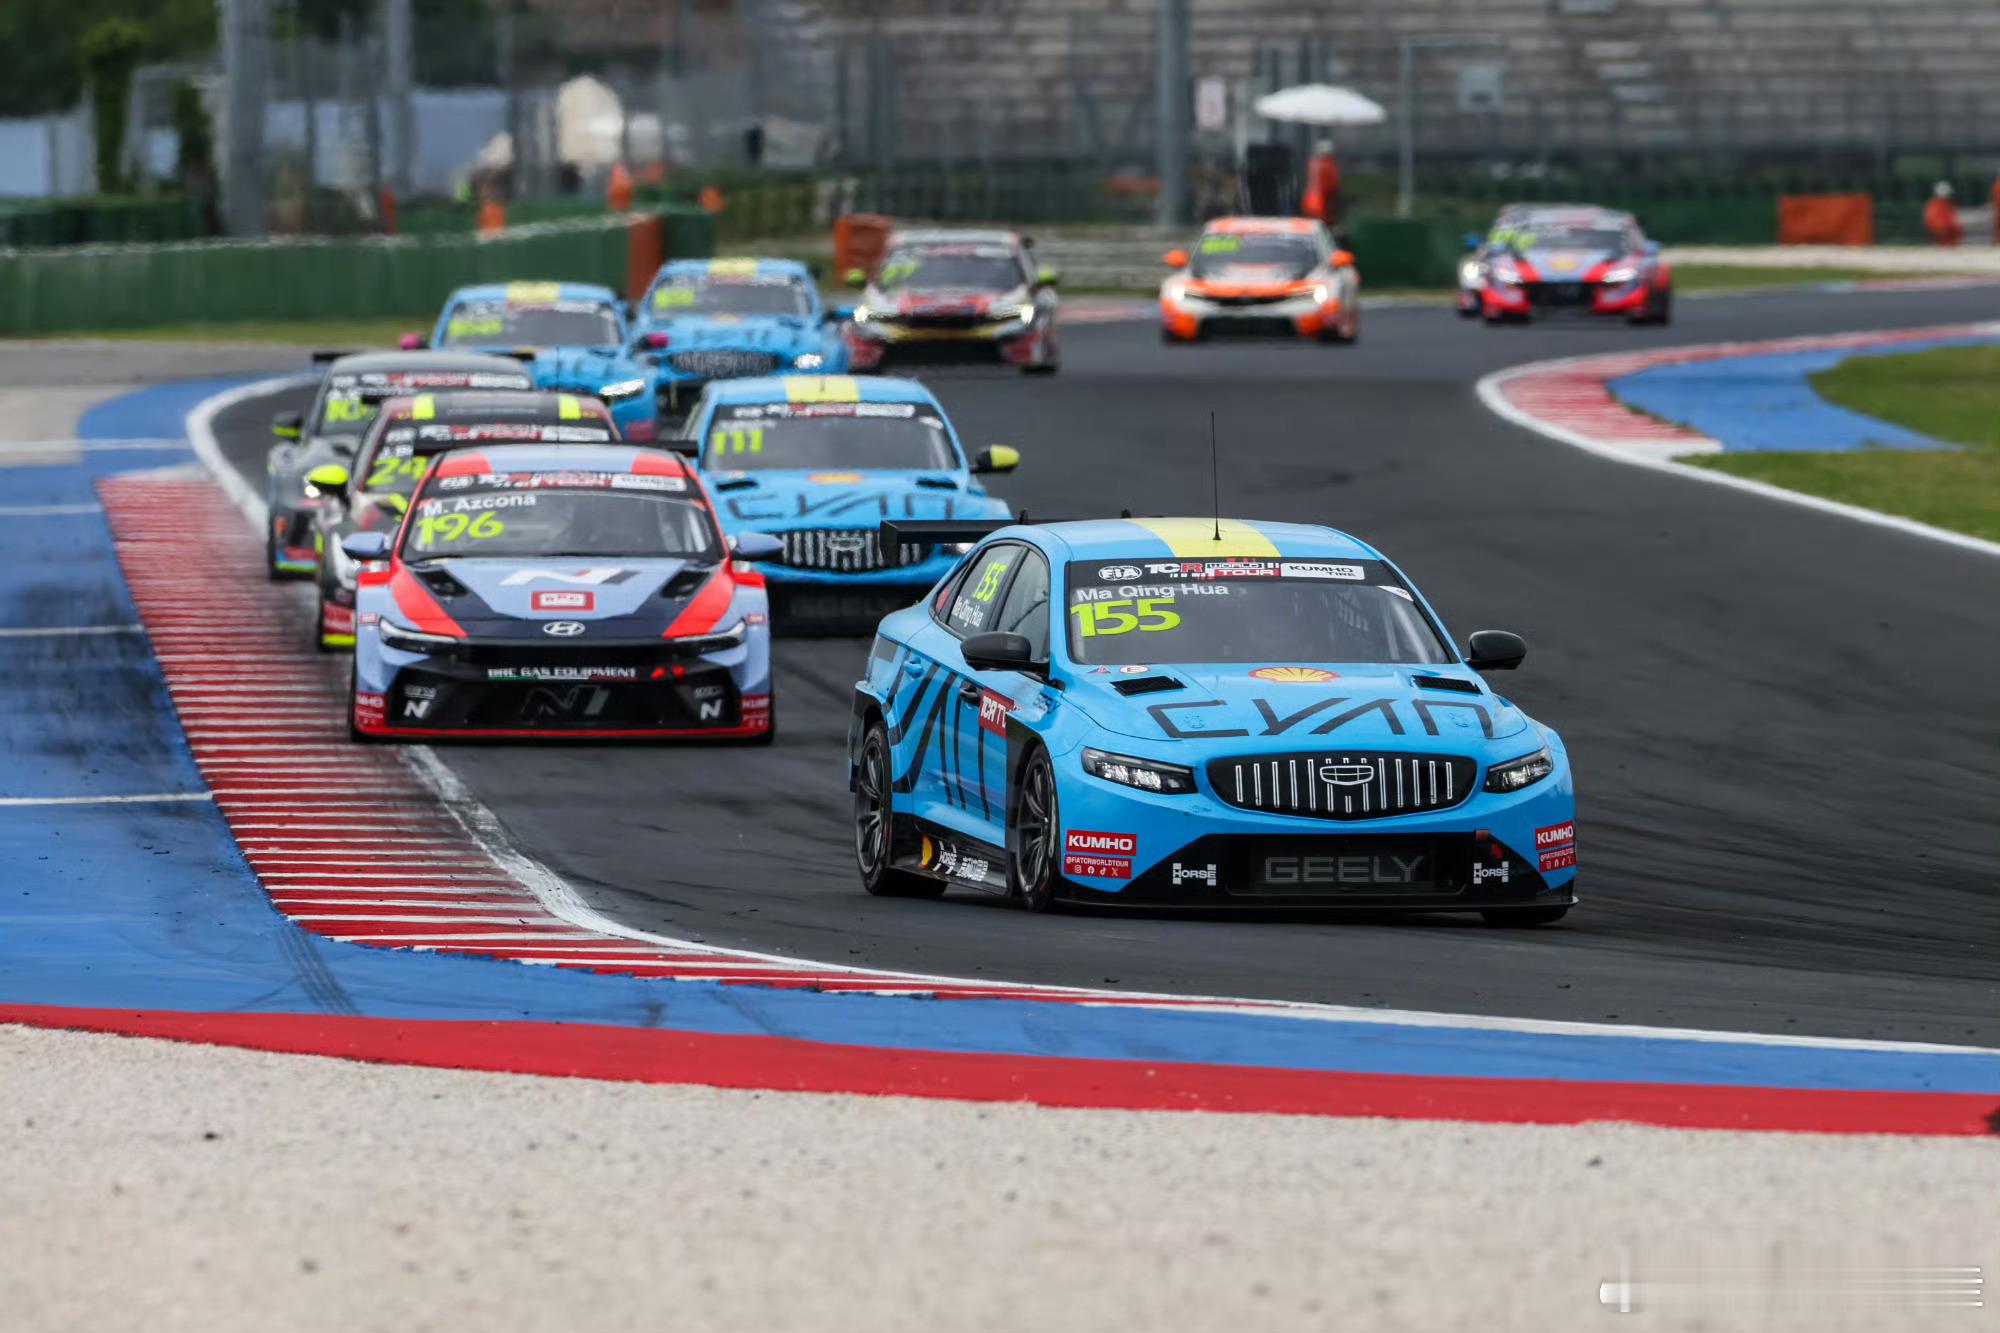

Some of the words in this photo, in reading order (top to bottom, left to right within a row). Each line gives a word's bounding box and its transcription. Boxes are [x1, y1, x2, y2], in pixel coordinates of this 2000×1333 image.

[713, 429, 764, 455] 111
[367, 456, 428, 486] 24
[424, 501, 449, 517] M.
[454, 494, 537, 512] Azcona
[416, 511, 505, 545] 196
[1100, 566, 1142, 580] FIA
[1145, 563, 1202, 574] TCR
[1219, 569, 1275, 577] TOUR
[1289, 565, 1354, 573] KUMHO
[974, 561, 1007, 602] 155
[1075, 588, 1113, 602] Ma
[1118, 585, 1175, 598] Qing
[1182, 583, 1229, 595] Hua
[1070, 597, 1181, 638] 155
[553, 667, 636, 678] EQUIPMENT
[1069, 834, 1133, 851] KUMHO
[1537, 825, 1574, 845] KUMHO
[1172, 862, 1217, 886] HORSE
[1264, 855, 1425, 883] GEELY
[1473, 860, 1509, 885] HORSE
